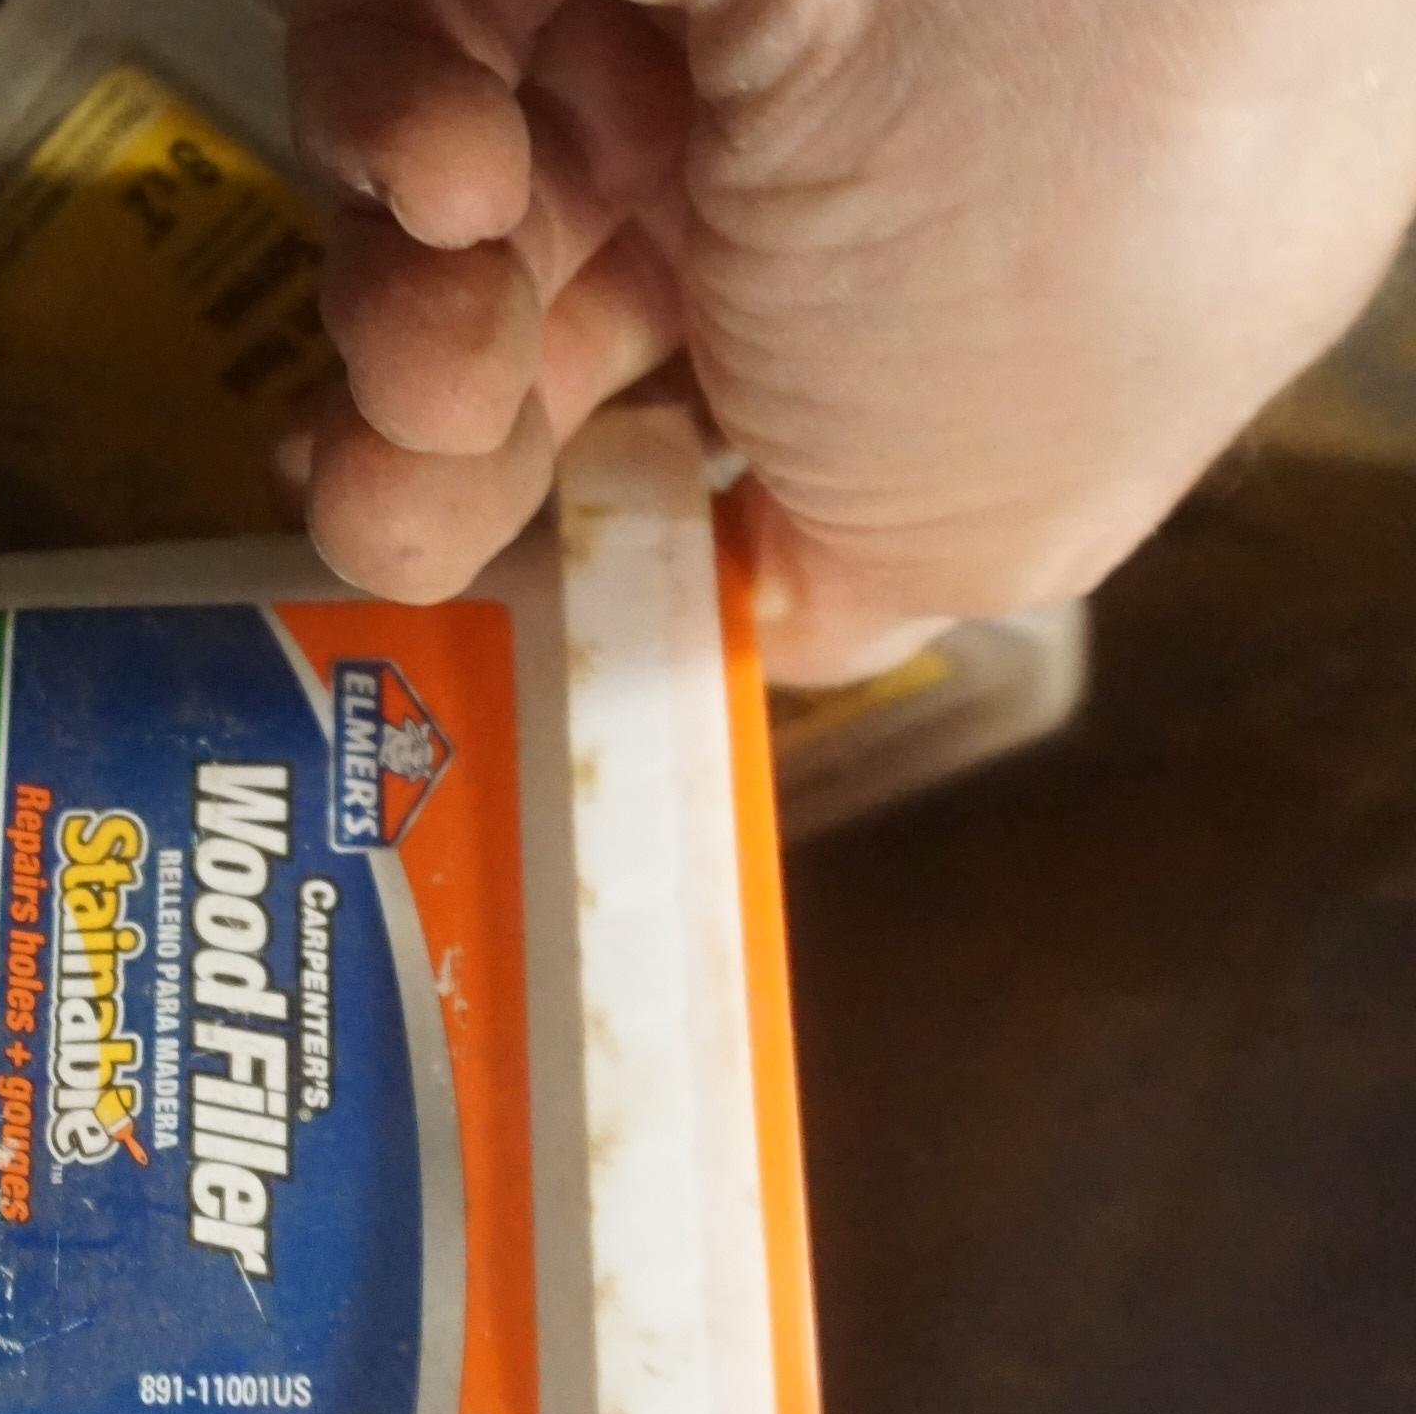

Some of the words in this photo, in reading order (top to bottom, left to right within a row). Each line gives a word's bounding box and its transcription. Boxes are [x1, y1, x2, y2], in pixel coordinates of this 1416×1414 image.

[340, 671, 379, 838] ELMER'S
[3, 784, 51, 923] Repairs
[155, 849, 182, 958] RELLENO
[192, 763, 289, 1020] Wood
[4, 930, 45, 1033] holes
[47, 811, 147, 1163] Stainable
[154, 963, 180, 1033] PARA
[300, 879, 337, 1109] CARPENTER'S
[4, 1040, 31, 1068] +
[153, 1038, 178, 1149] MADERA
[190, 1018, 288, 1276] Filler
[137, 1374, 311, 1408] 891-11001US
